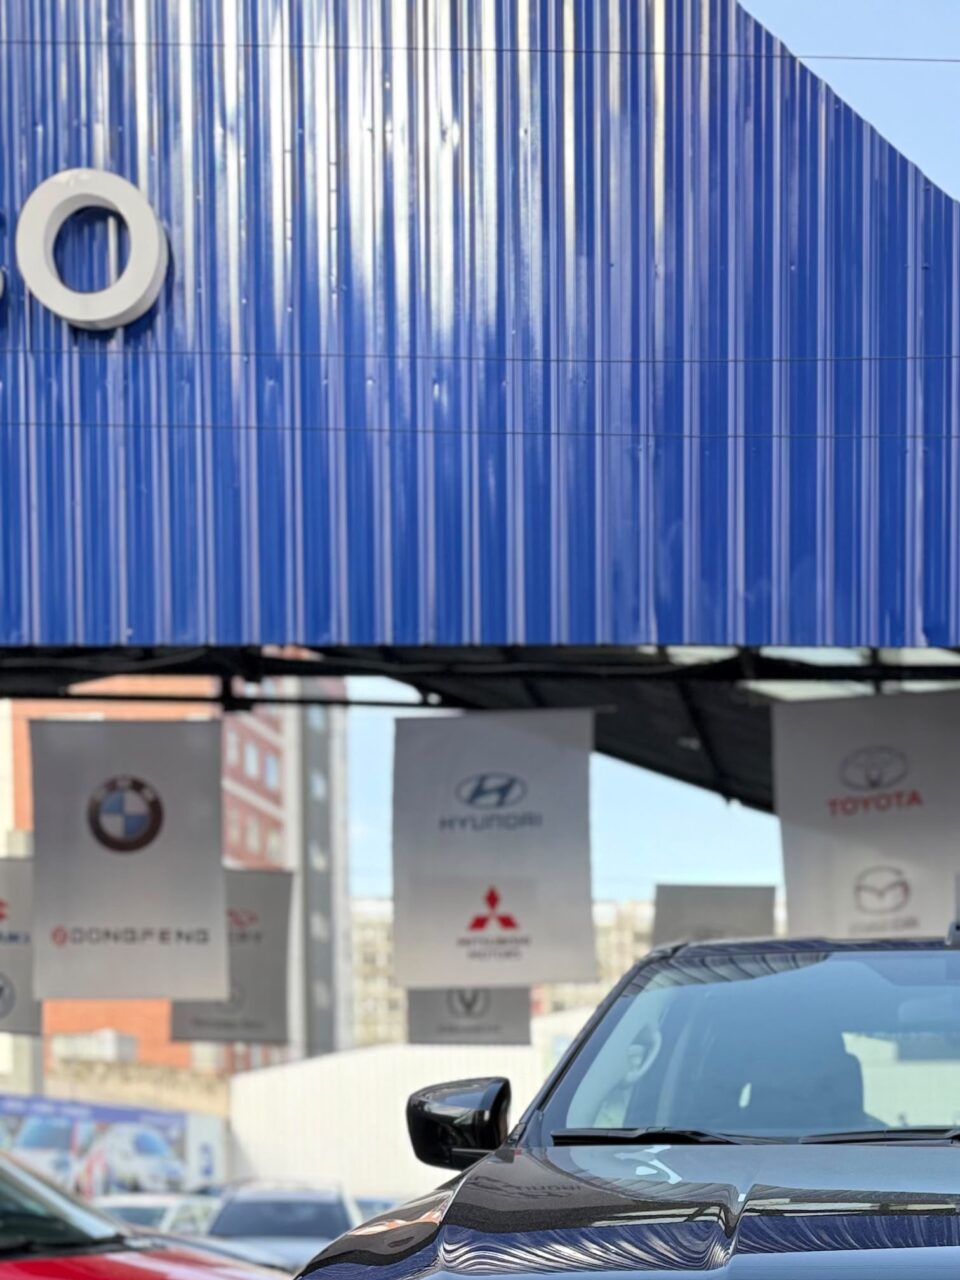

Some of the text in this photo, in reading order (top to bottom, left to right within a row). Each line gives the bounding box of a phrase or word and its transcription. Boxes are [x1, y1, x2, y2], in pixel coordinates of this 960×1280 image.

[0, 168, 169, 330] O
[825, 788, 923, 816] TOYOTA
[439, 813, 543, 831] HYUNDAI
[70, 927, 209, 945] DONGFENG
